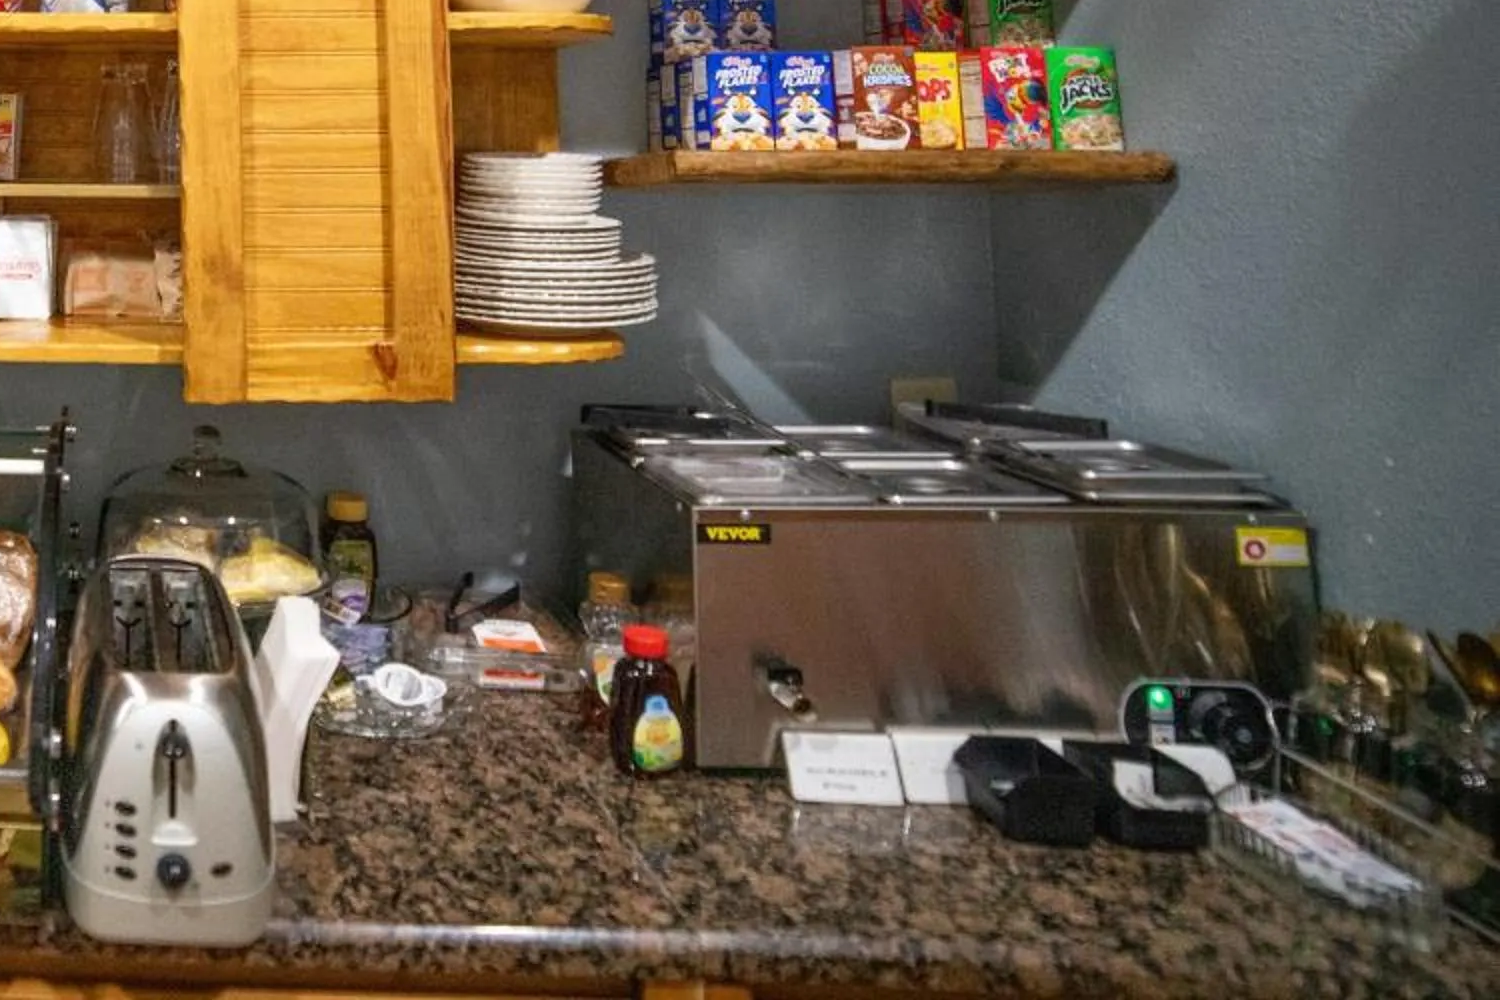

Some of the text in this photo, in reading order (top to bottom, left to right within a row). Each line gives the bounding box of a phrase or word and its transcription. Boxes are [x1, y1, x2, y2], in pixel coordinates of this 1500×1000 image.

[868, 63, 906, 74] COCOA
[917, 77, 952, 103] OPS
[1060, 83, 1113, 114] JACKS
[706, 526, 760, 540] VEVOR
